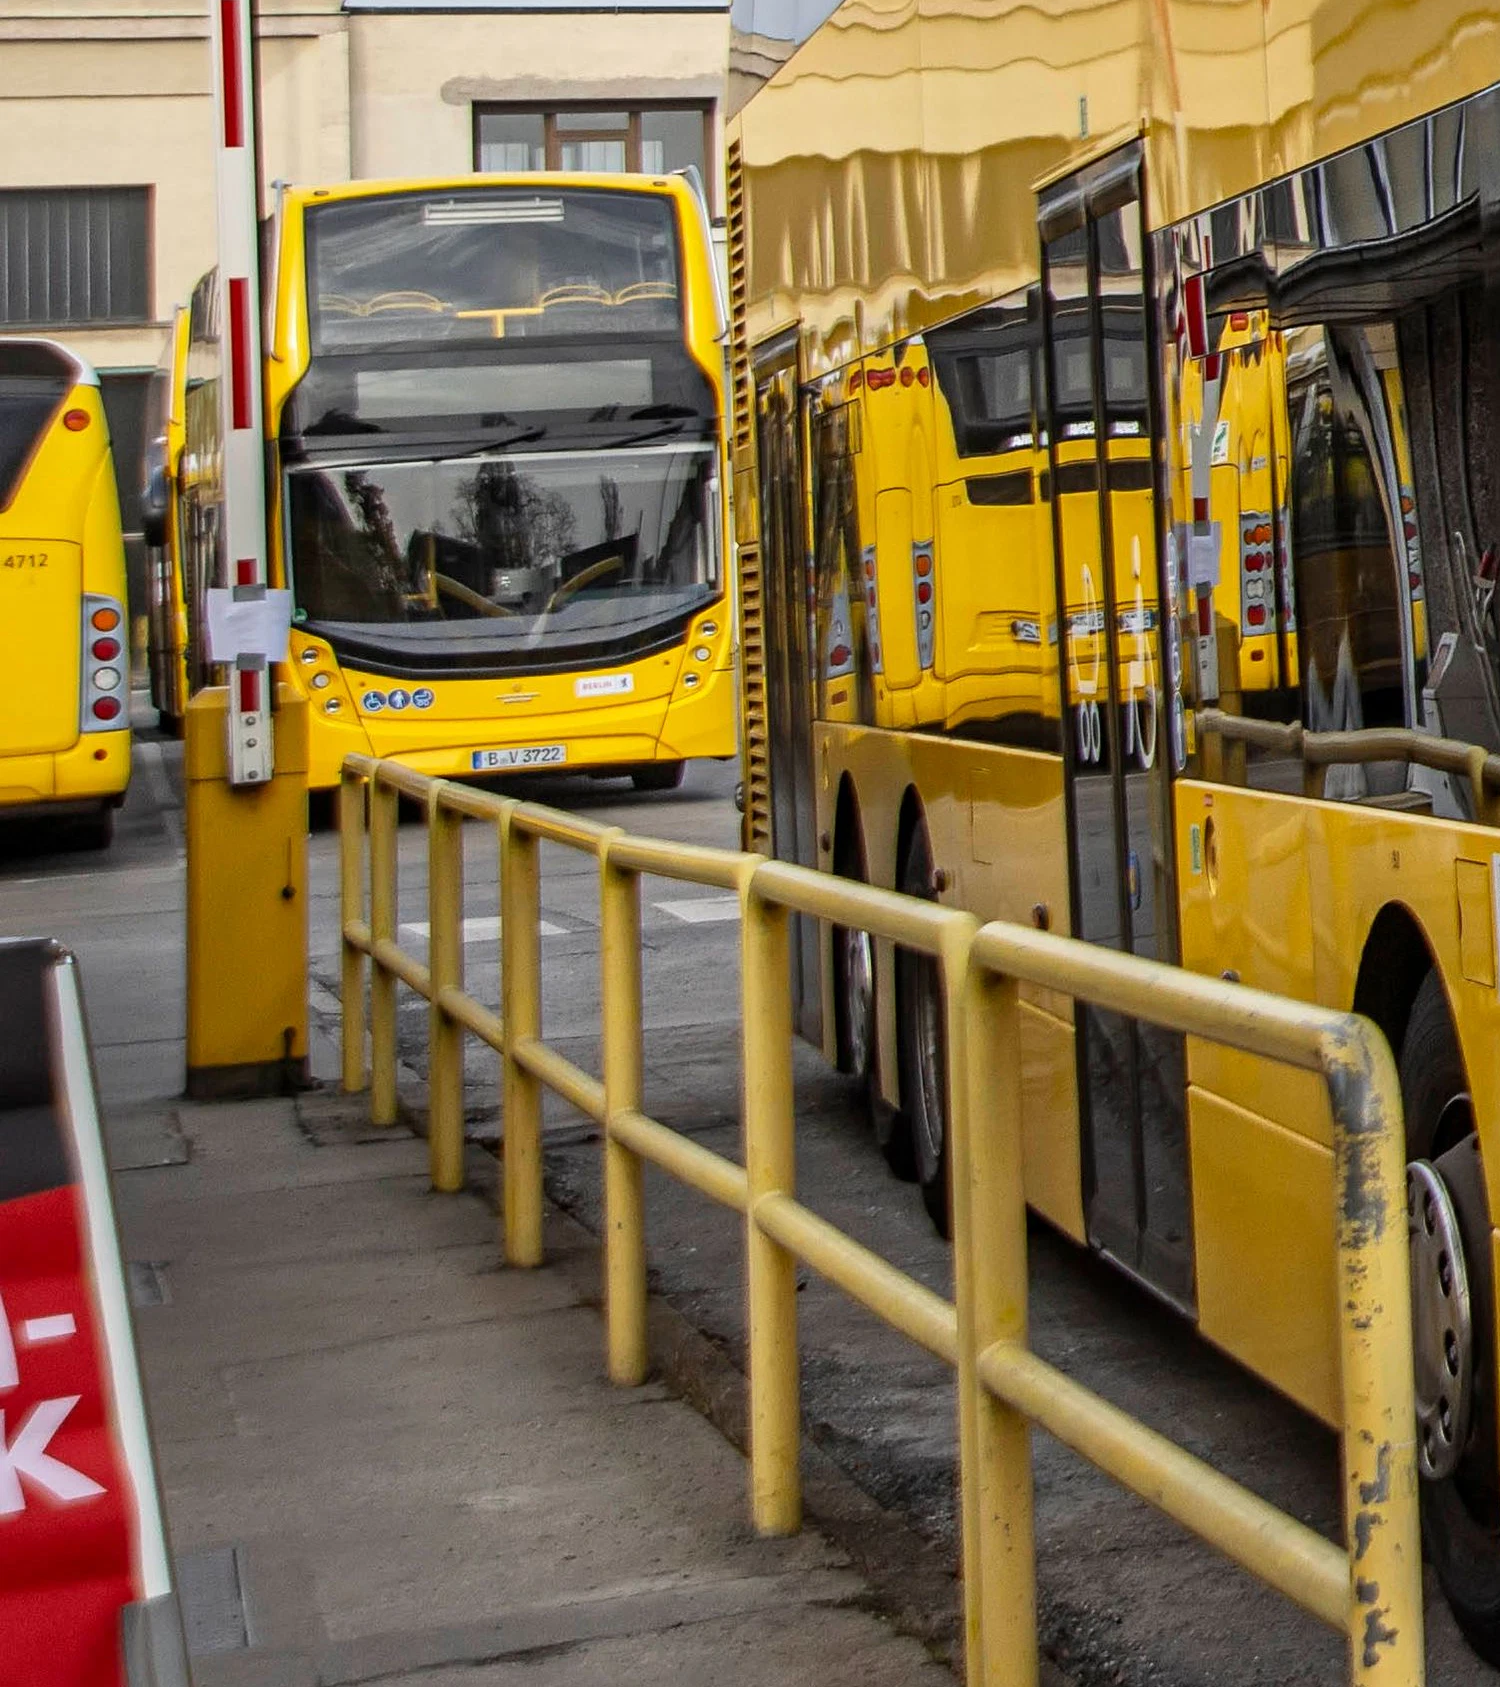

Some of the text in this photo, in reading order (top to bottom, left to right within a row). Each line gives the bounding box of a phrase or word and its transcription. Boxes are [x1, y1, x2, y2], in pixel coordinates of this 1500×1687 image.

[4, 553, 48, 568] 4712
[488, 747, 560, 765] B V 3722
